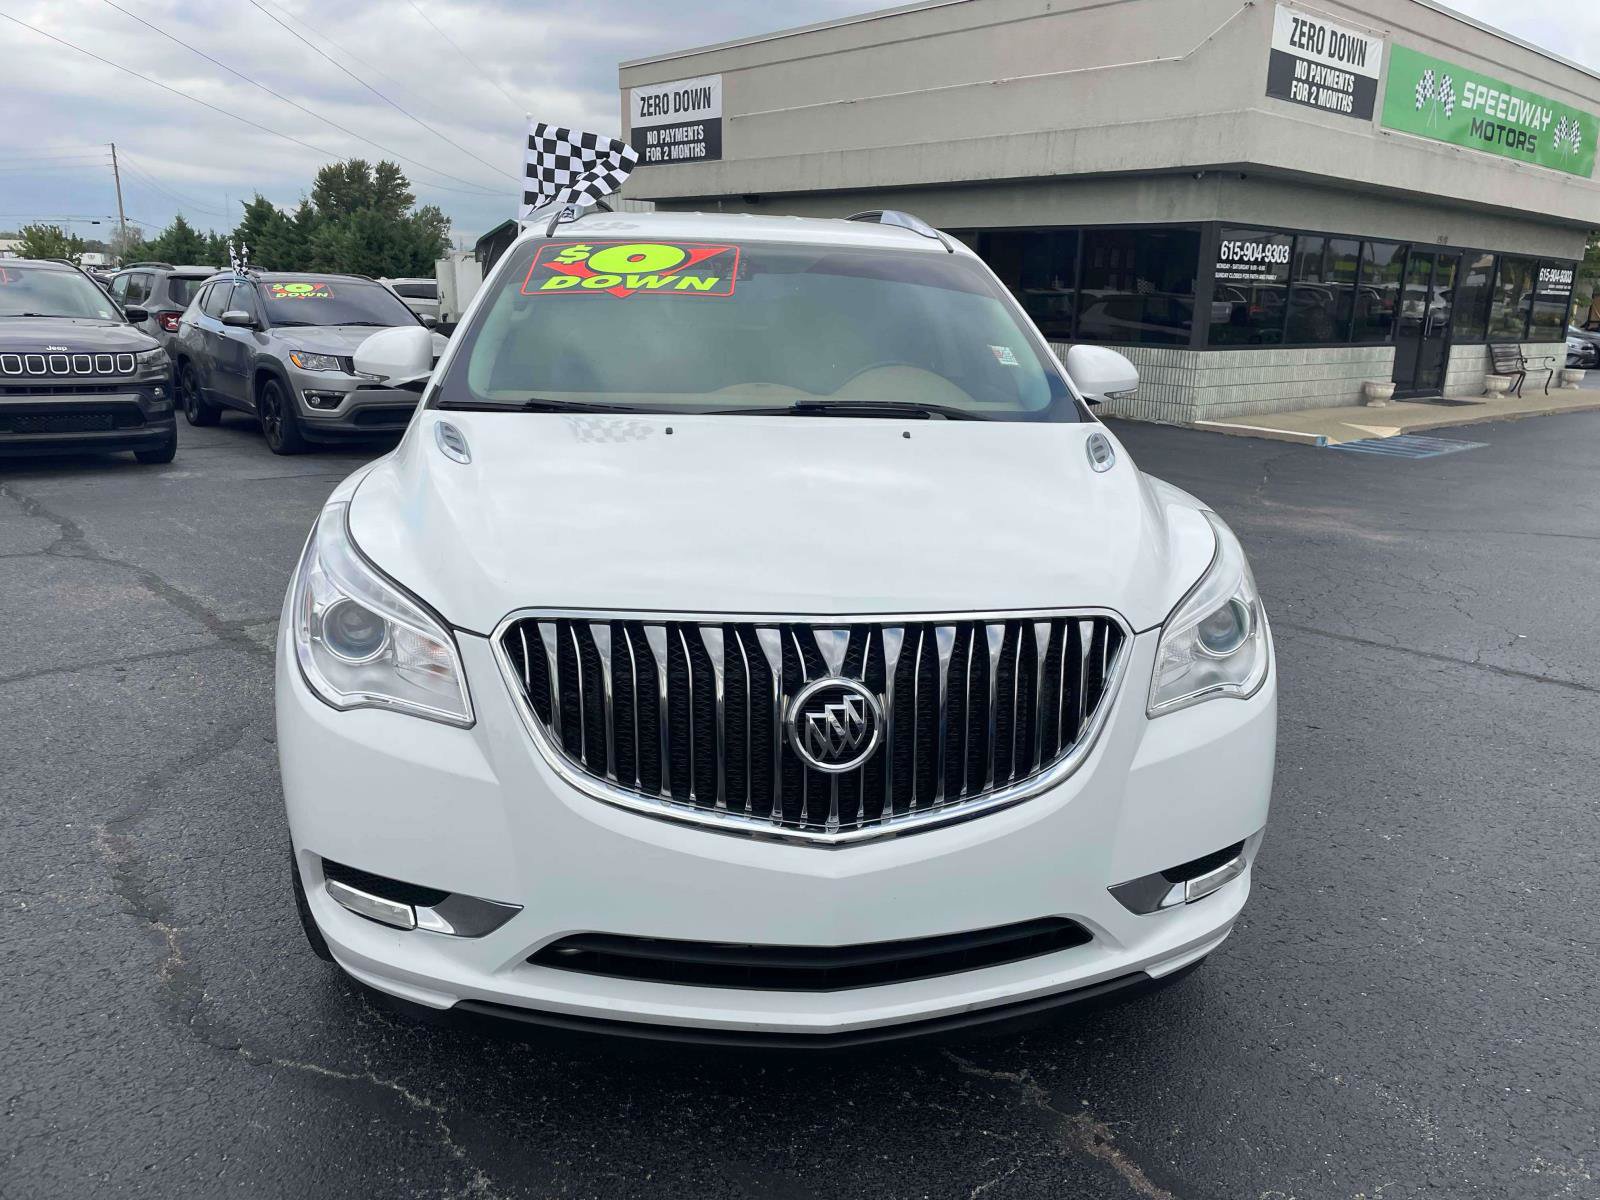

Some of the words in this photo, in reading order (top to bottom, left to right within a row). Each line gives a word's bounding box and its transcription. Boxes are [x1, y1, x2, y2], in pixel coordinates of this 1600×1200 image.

[1290, 17, 1326, 55] ZERO
[1328, 30, 1368, 67] DOWN
[1295, 60, 1308, 80] NO
[1309, 64, 1355, 92] PAYMENTS
[640, 93, 670, 117] ZERO
[674, 87, 711, 112] DOWN
[1290, 81, 1309, 102] FOR
[1310, 86, 1317, 104] 2
[1318, 88, 1354, 113] MONTHS
[1461, 81, 1552, 132] SPEEDWAY
[647, 130, 658, 144] NO
[660, 125, 704, 144] PAYMENTS
[1470, 117, 1537, 153] MOTORS
[646, 147, 662, 161] FOR
[664, 146, 669, 160] 2
[671, 142, 706, 159] MONTHS
[553, 244, 686, 274] $0
[1220, 240, 1289, 264] 615-904-9303
[540, 274, 720, 291] DOWN
